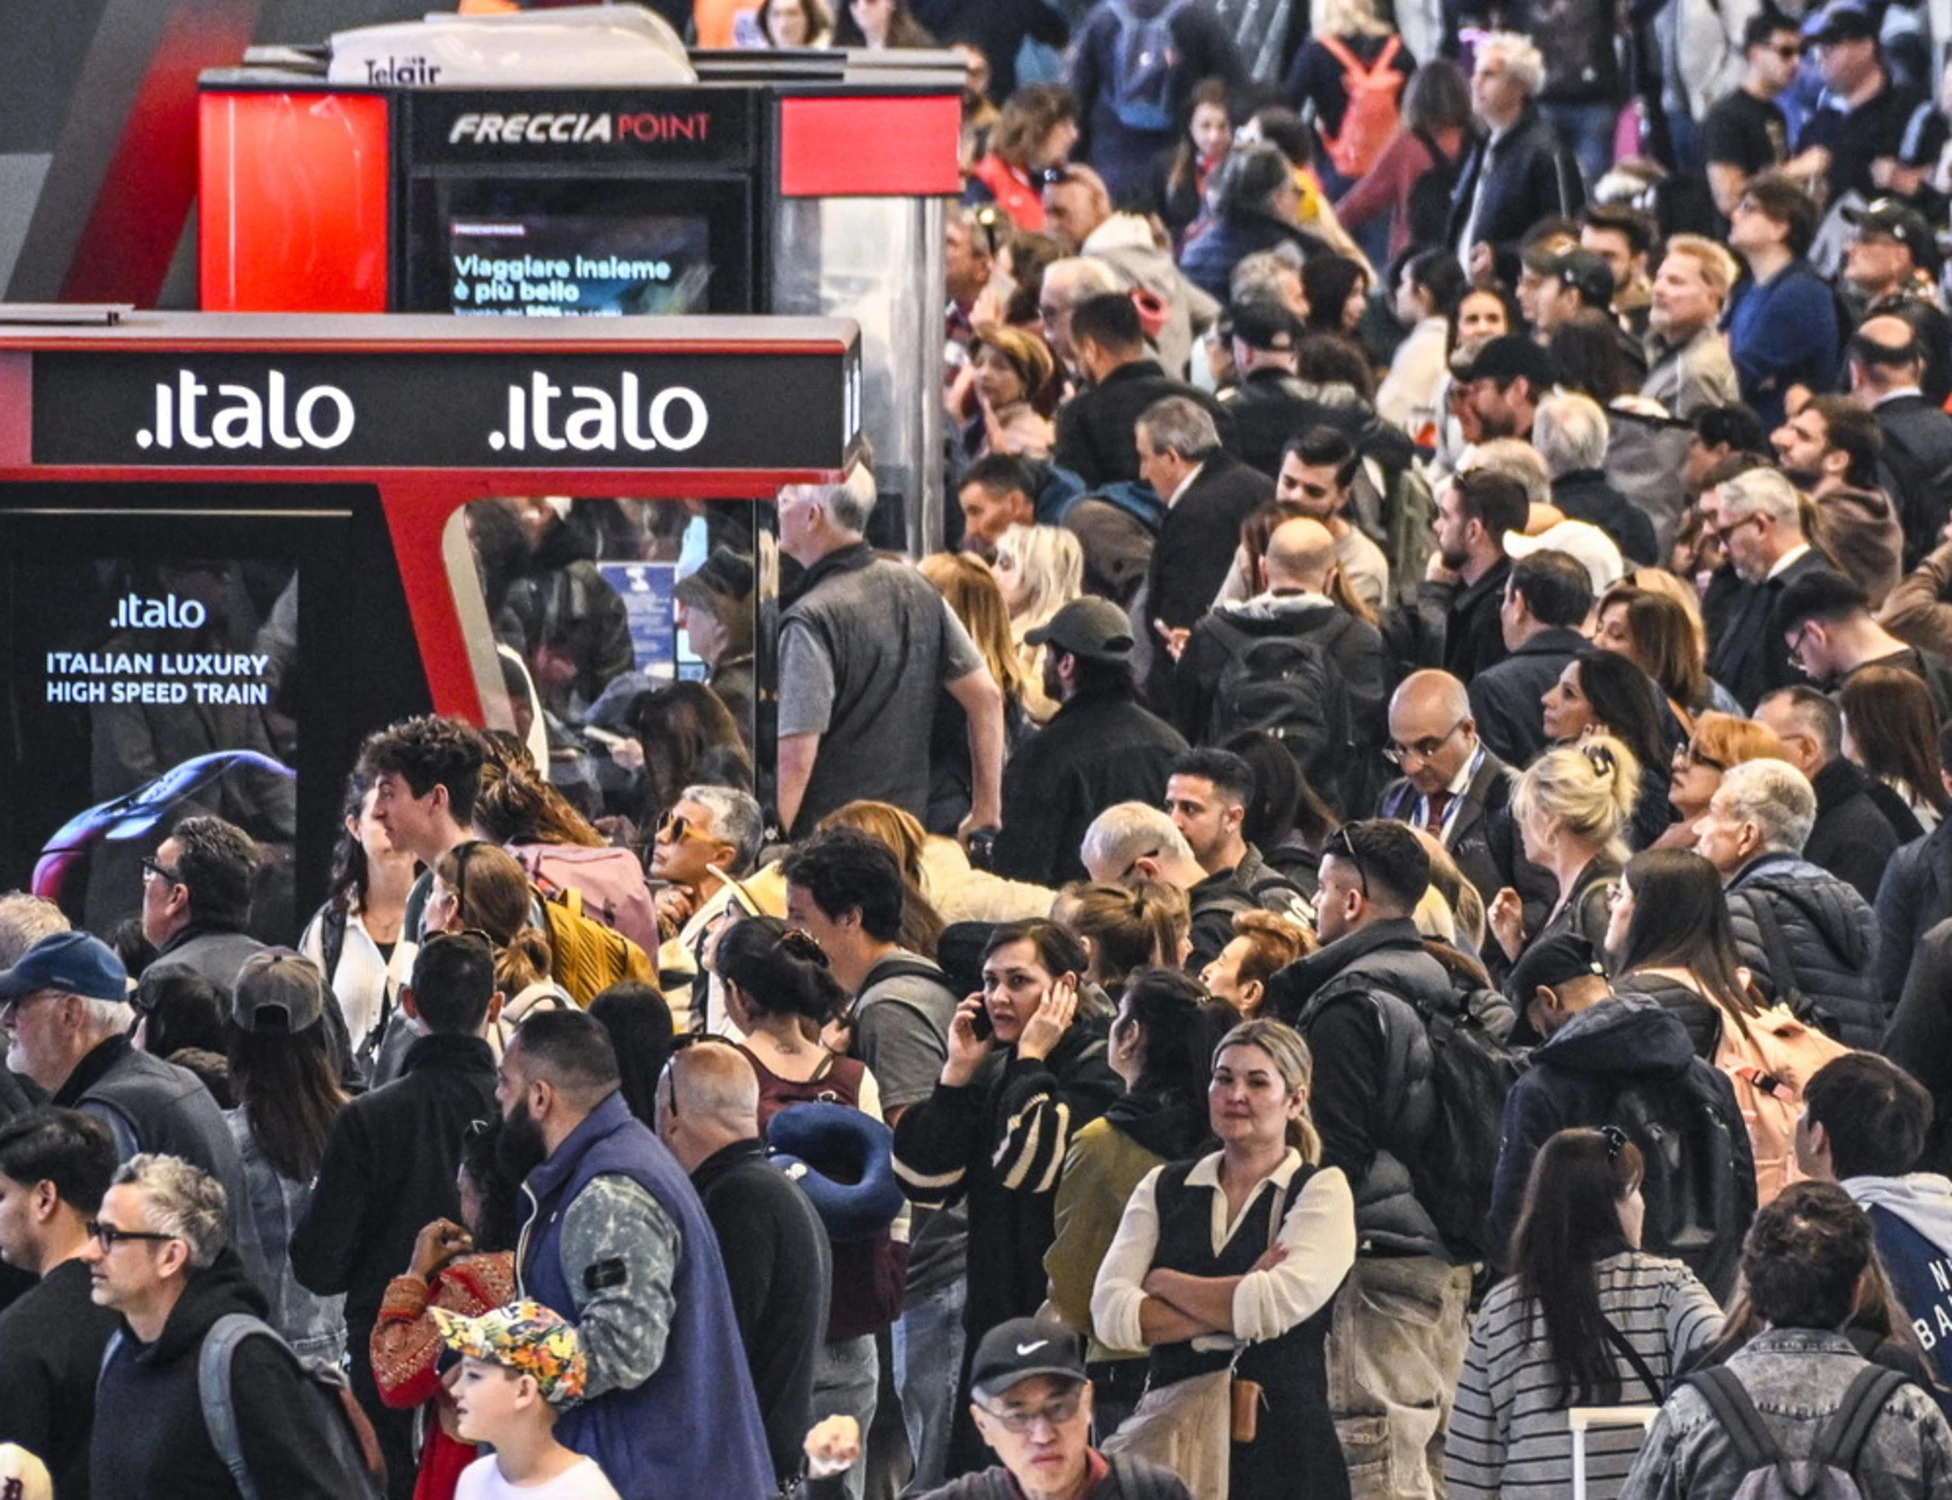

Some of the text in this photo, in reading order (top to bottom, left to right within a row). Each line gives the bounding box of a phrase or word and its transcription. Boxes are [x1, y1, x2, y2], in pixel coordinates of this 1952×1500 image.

[453, 254, 671, 281] Viaggiare insieme
[453, 278, 580, 304] è più bello
[47, 653, 268, 675] ITALIAN LUXURY
[47, 681, 268, 704] HIGH SPEED TRAIN
[1928, 1258, 1952, 1292] N
[1912, 1295, 1952, 1351] BA
